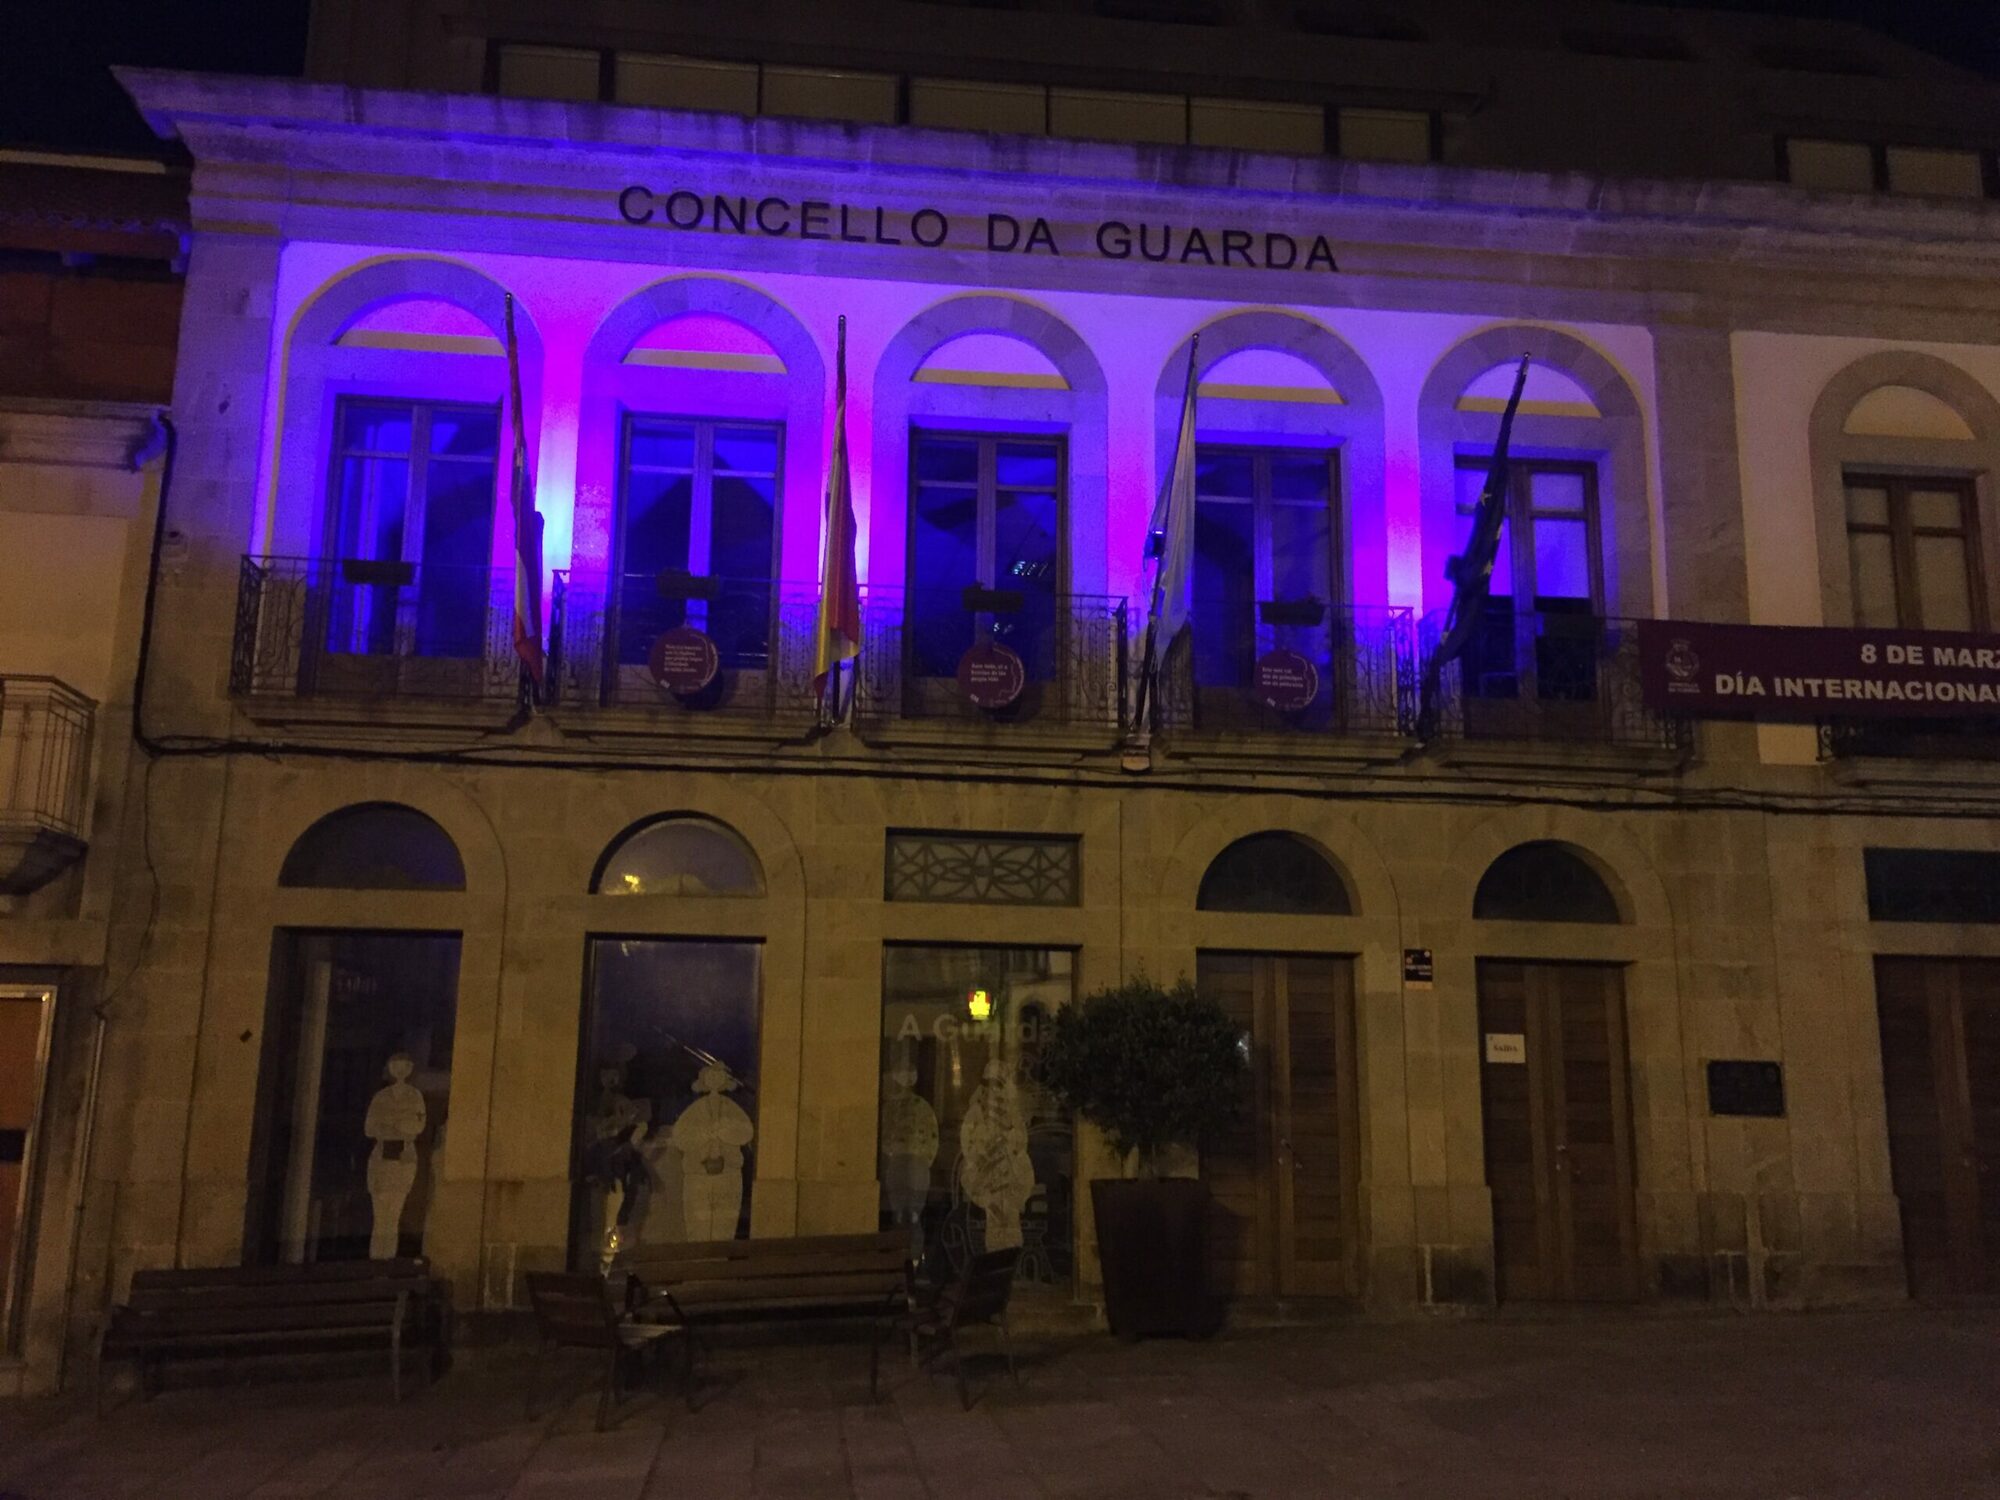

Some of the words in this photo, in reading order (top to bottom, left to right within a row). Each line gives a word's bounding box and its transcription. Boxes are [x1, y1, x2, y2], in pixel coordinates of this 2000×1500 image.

[617, 186, 949, 249] CONCELLO
[986, 212, 1061, 257] DA
[1096, 221, 1340, 274] GUARDA
[1860, 643, 1878, 665] 8
[1886, 644, 1925, 666] DE
[1715, 670, 1766, 697] DÍA
[1773, 677, 2000, 703] INTERNACIONA
